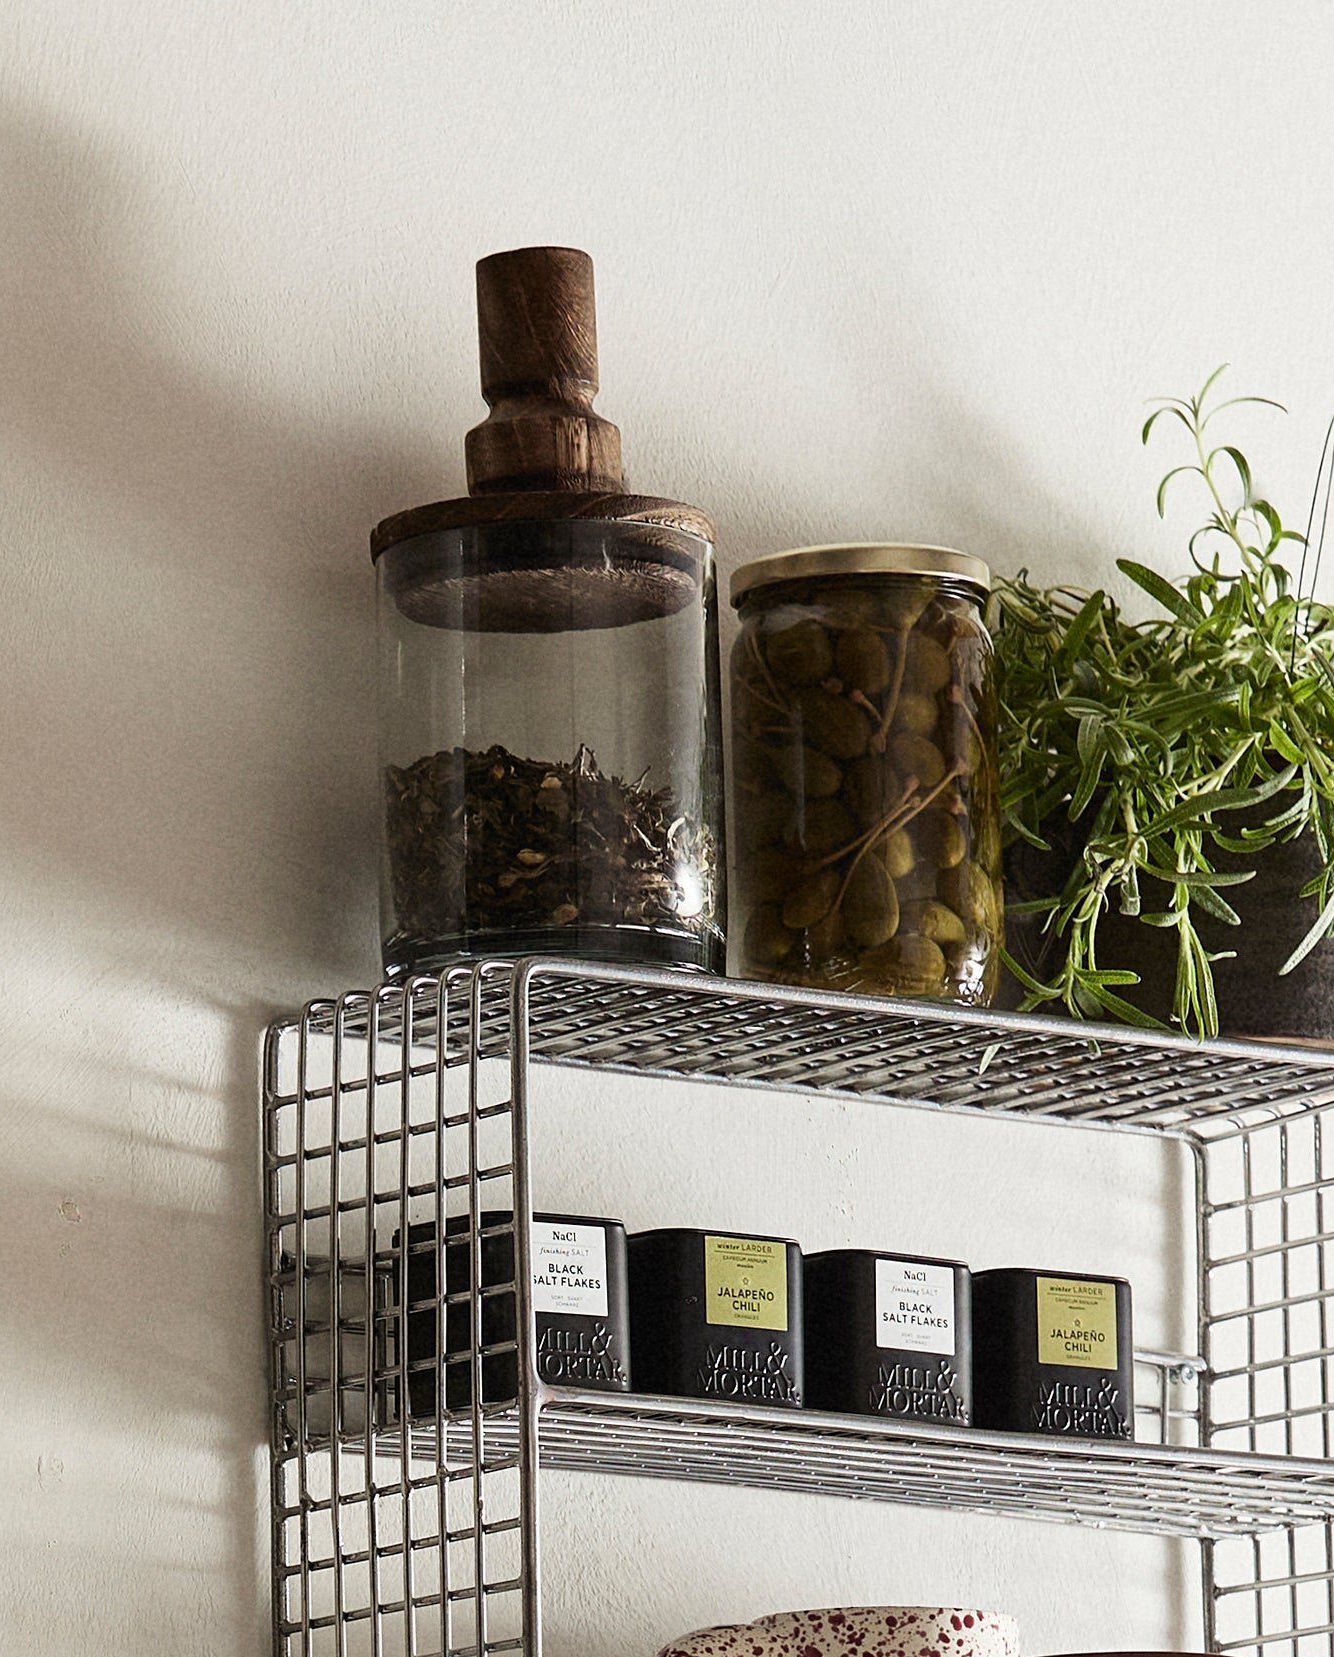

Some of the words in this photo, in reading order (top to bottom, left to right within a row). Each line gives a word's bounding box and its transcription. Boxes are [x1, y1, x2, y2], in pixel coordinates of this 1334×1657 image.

[552, 1231, 577, 1242] NaCl
[741, 1244, 772, 1253] LARDER
[548, 1263, 584, 1275] BLACK
[904, 1270, 927, 1281] NaCl
[561, 1277, 601, 1289] FLAKES
[717, 1287, 775, 1301] JALAPEÑO
[1072, 1286, 1103, 1296] LARDER
[732, 1301, 761, 1312] CHILI
[899, 1302, 932, 1314] BLACK
[883, 1312, 908, 1324] SALT
[911, 1315, 949, 1328] FLAKES
[1050, 1329, 1106, 1342] JALAPEÑO
[1064, 1342, 1092, 1353] CHILI
